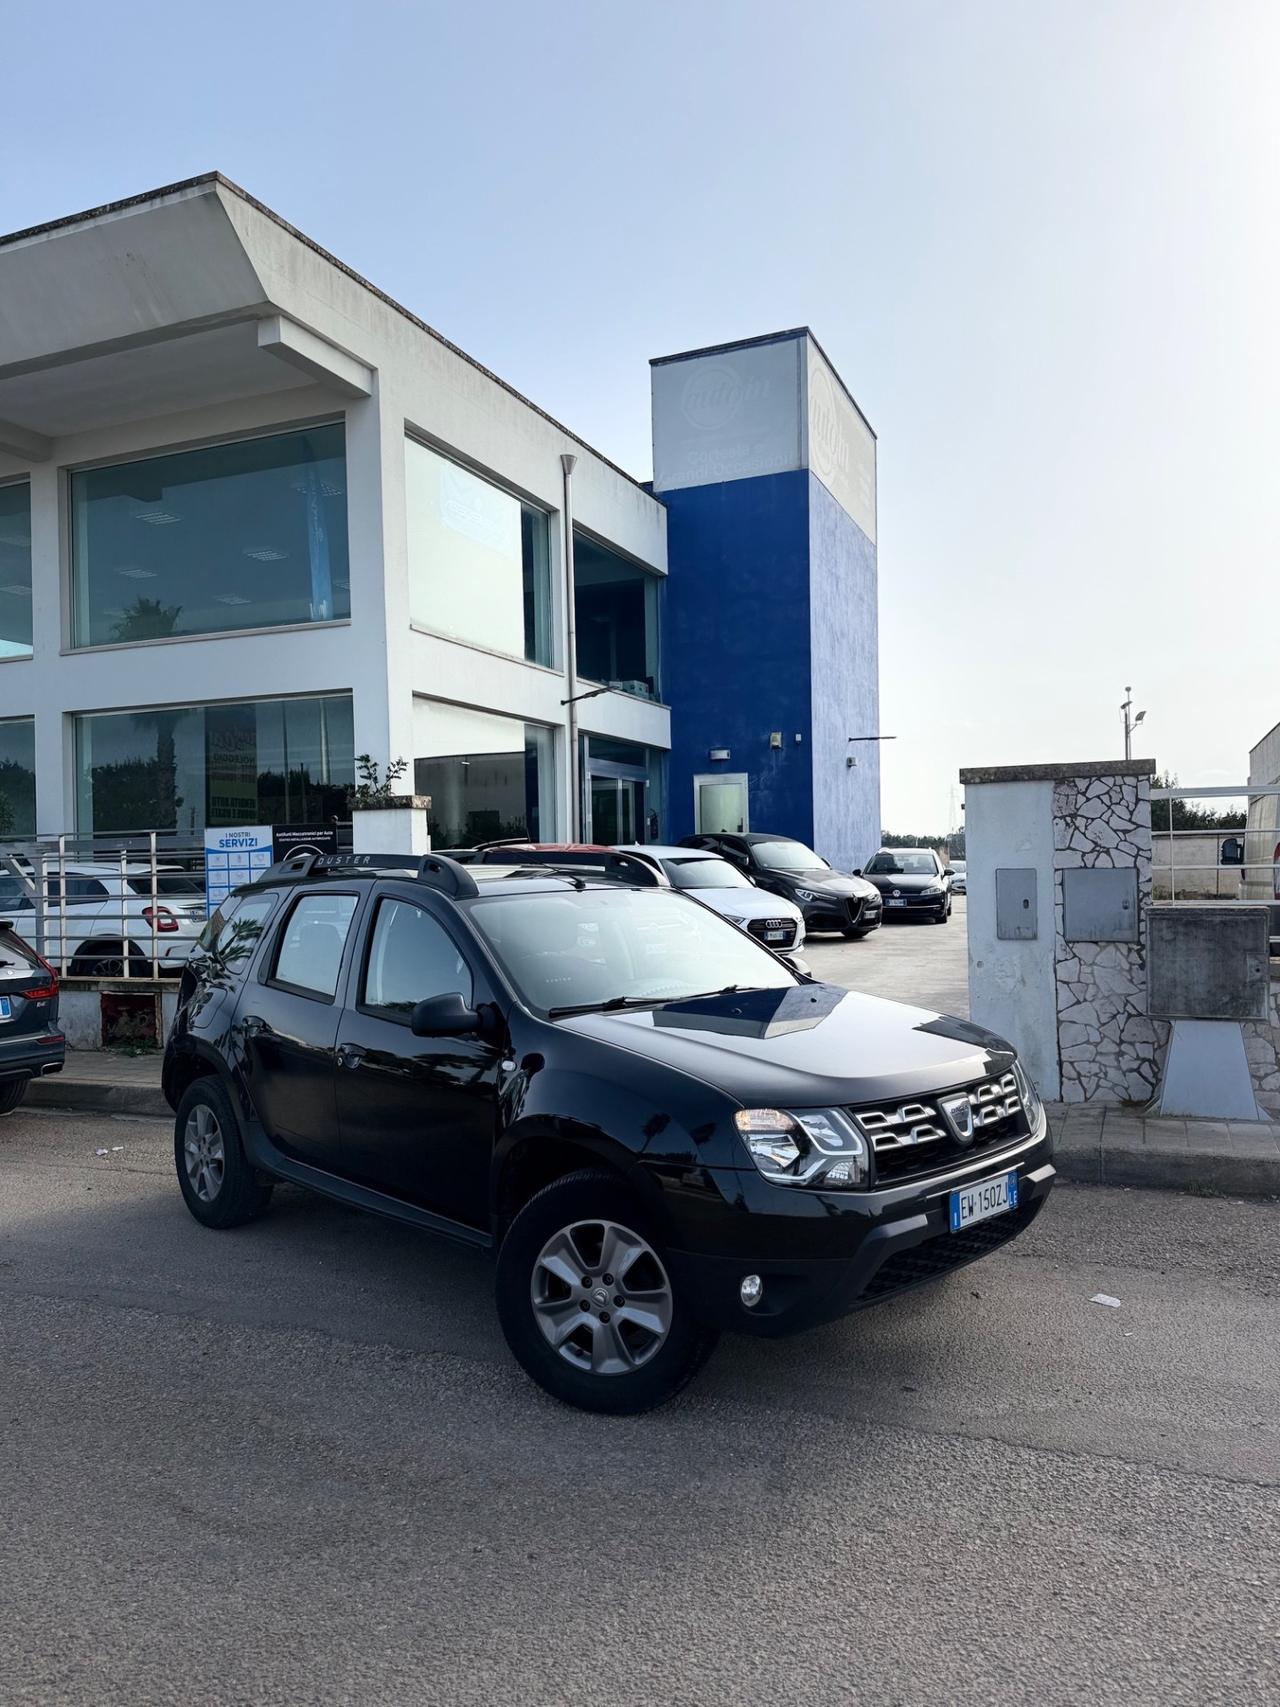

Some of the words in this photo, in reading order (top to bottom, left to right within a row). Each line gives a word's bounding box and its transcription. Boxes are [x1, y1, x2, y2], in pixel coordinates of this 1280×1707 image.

[219, 837, 258, 848] SERVIZI
[317, 855, 371, 865] DUSTER
[1008, 1190, 1018, 1206] LE
